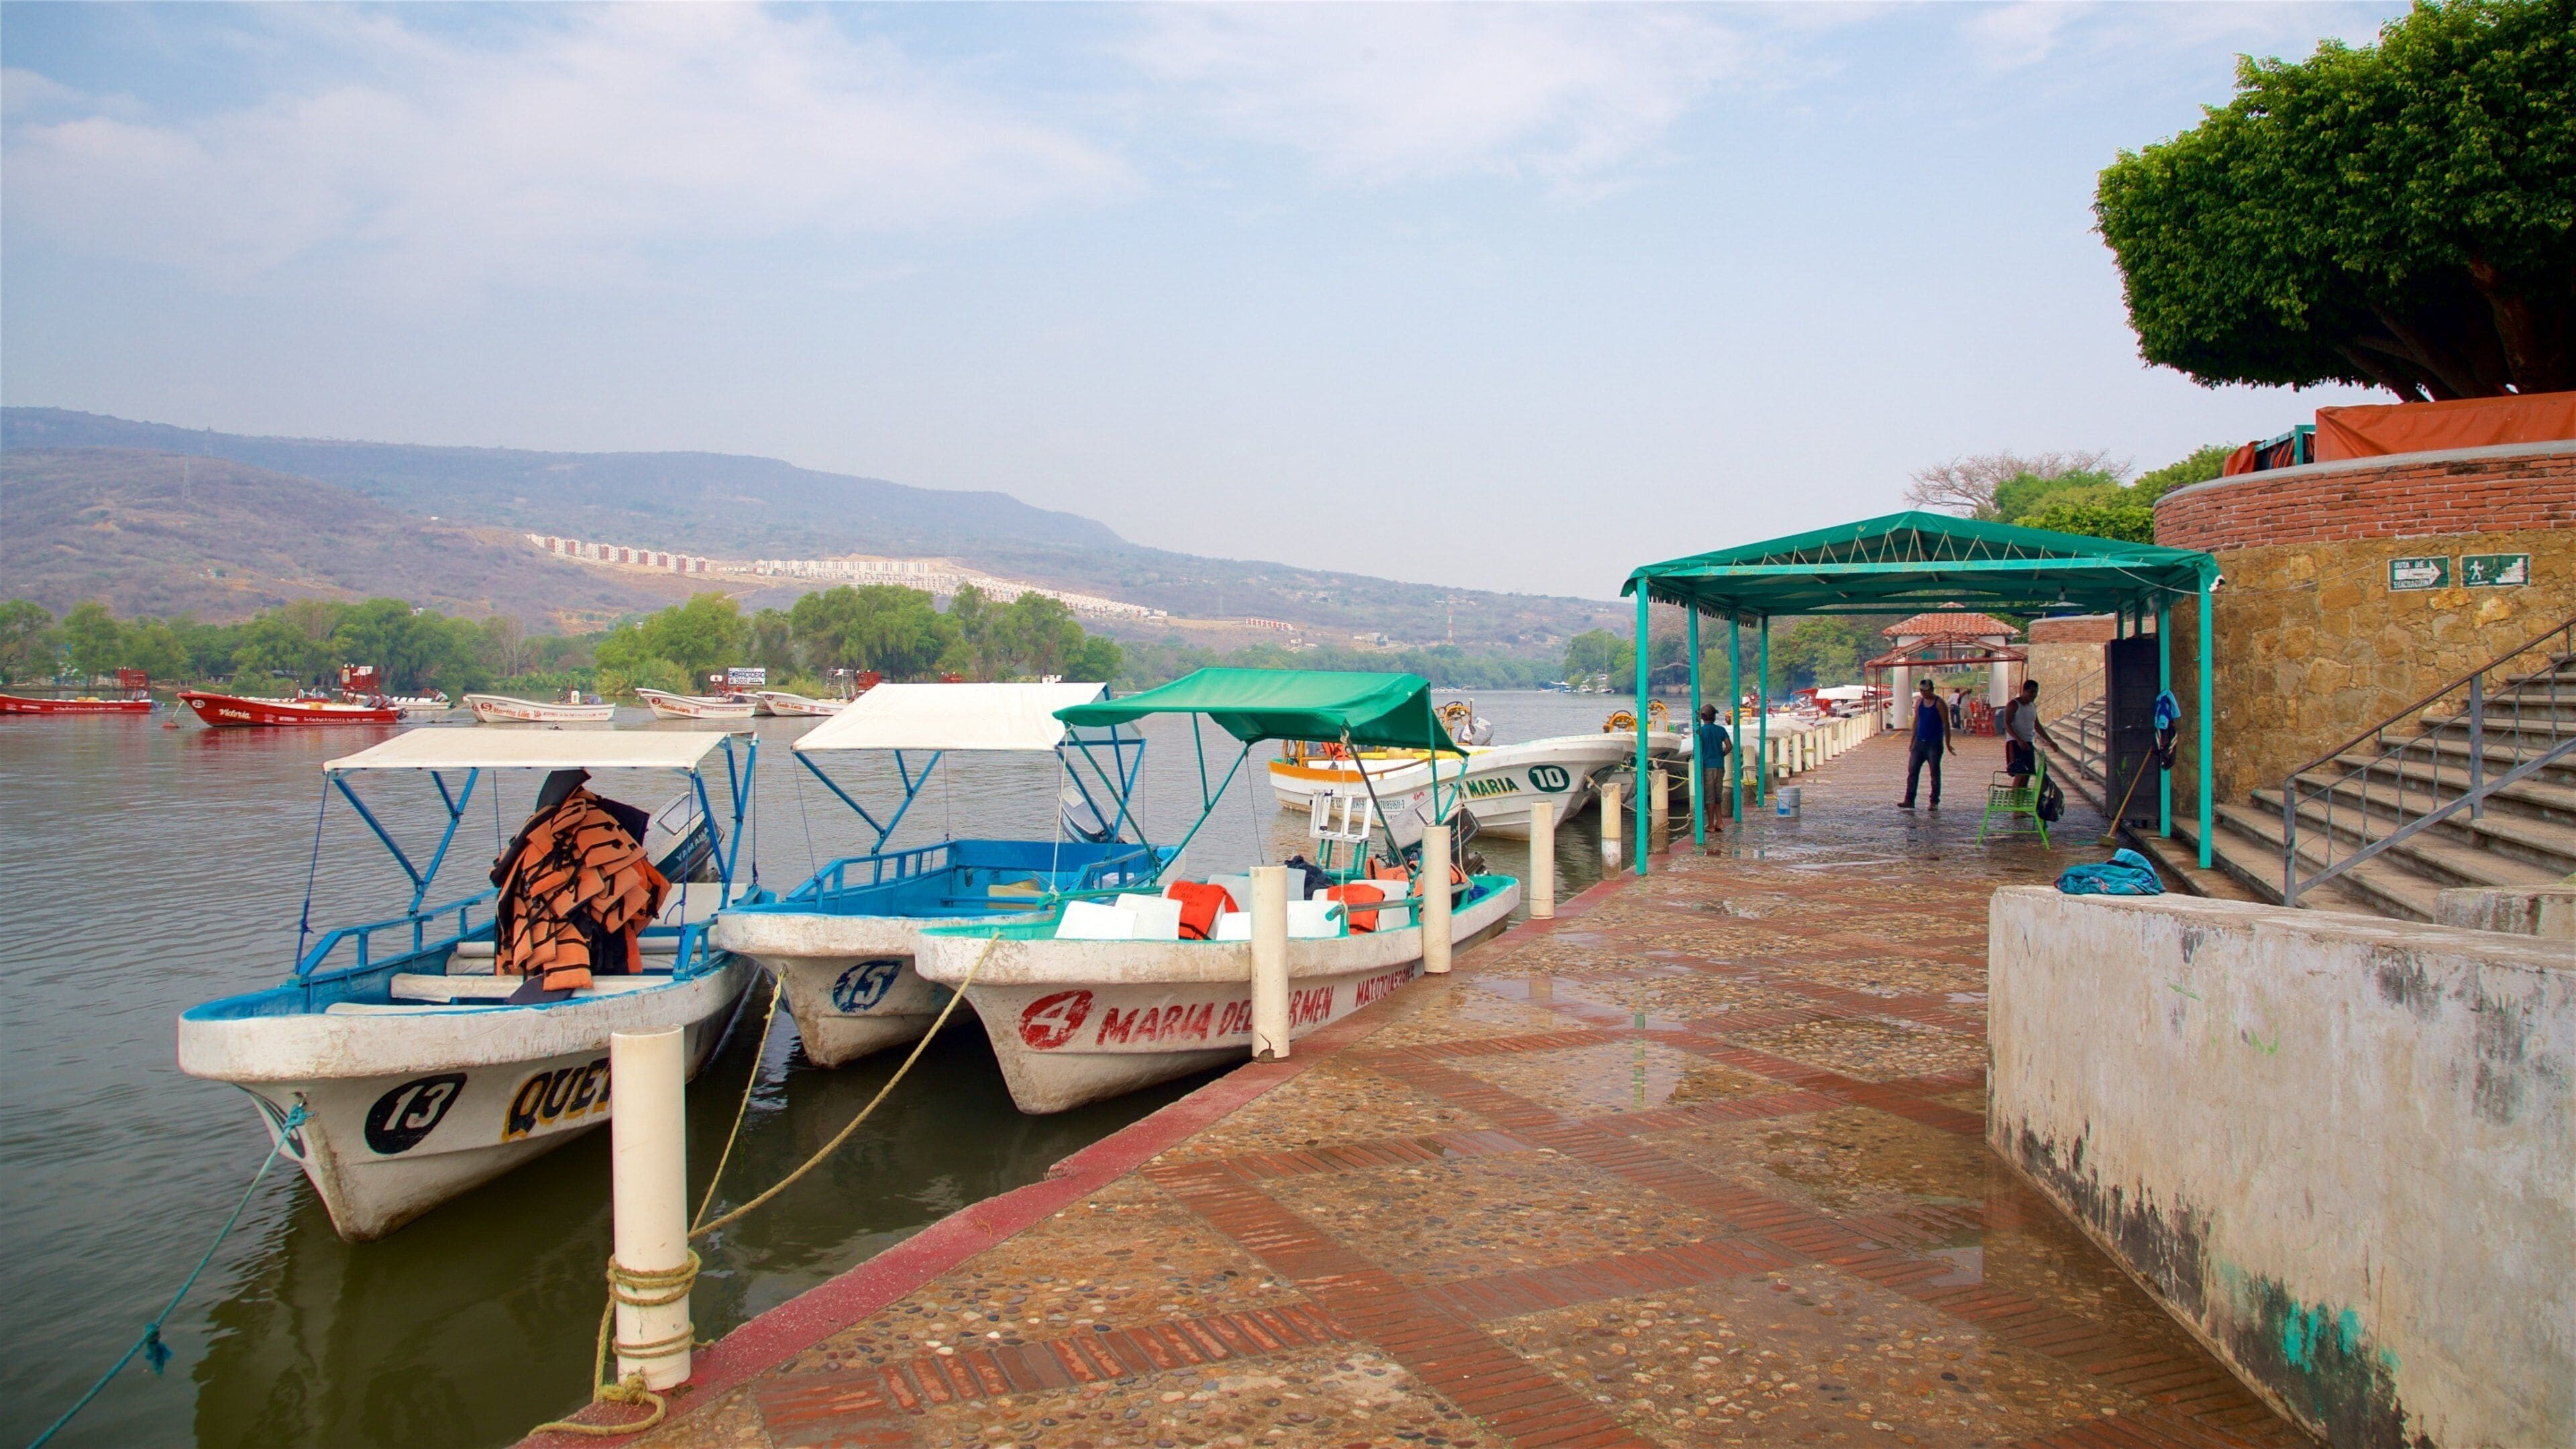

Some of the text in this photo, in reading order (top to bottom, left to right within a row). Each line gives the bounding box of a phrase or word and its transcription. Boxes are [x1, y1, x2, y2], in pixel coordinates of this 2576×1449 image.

[2394, 560, 2424, 569] RUTA DE
[1465, 777, 1521, 799] MARIA
[1531, 768, 1566, 788] 10
[676, 826, 710, 862] YAMAHA
[837, 964, 895, 1006] 15
[1095, 1002, 1215, 1046] MARIA
[1217, 999, 1252, 1038] DEL
[1288, 985, 1335, 1029] RMEN
[383, 1082, 455, 1132] 13
